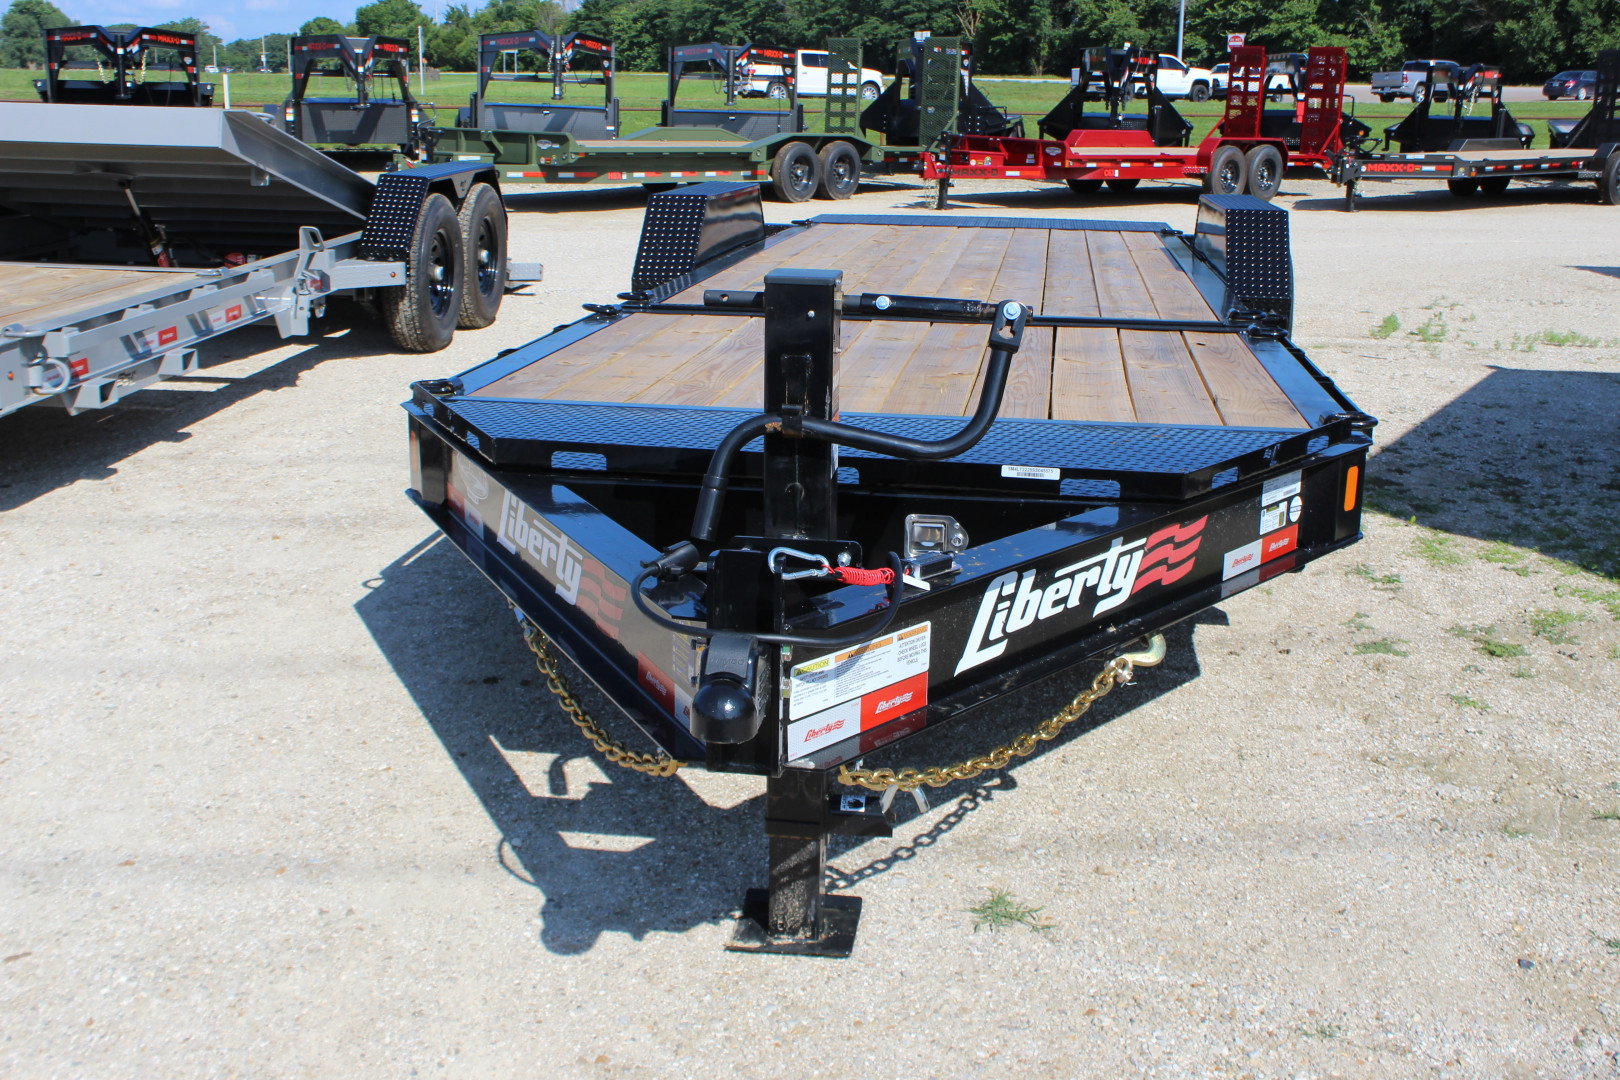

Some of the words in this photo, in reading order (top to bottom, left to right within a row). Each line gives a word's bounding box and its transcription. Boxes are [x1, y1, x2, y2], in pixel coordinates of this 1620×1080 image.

[952, 168, 998, 176] MAXX-D
[1366, 158, 1414, 172] MAXX-D
[496, 489, 584, 606] Liberty
[954, 536, 1147, 678] Liberty
[875, 694, 902, 714] Liberty
[804, 722, 834, 742] Liberty
